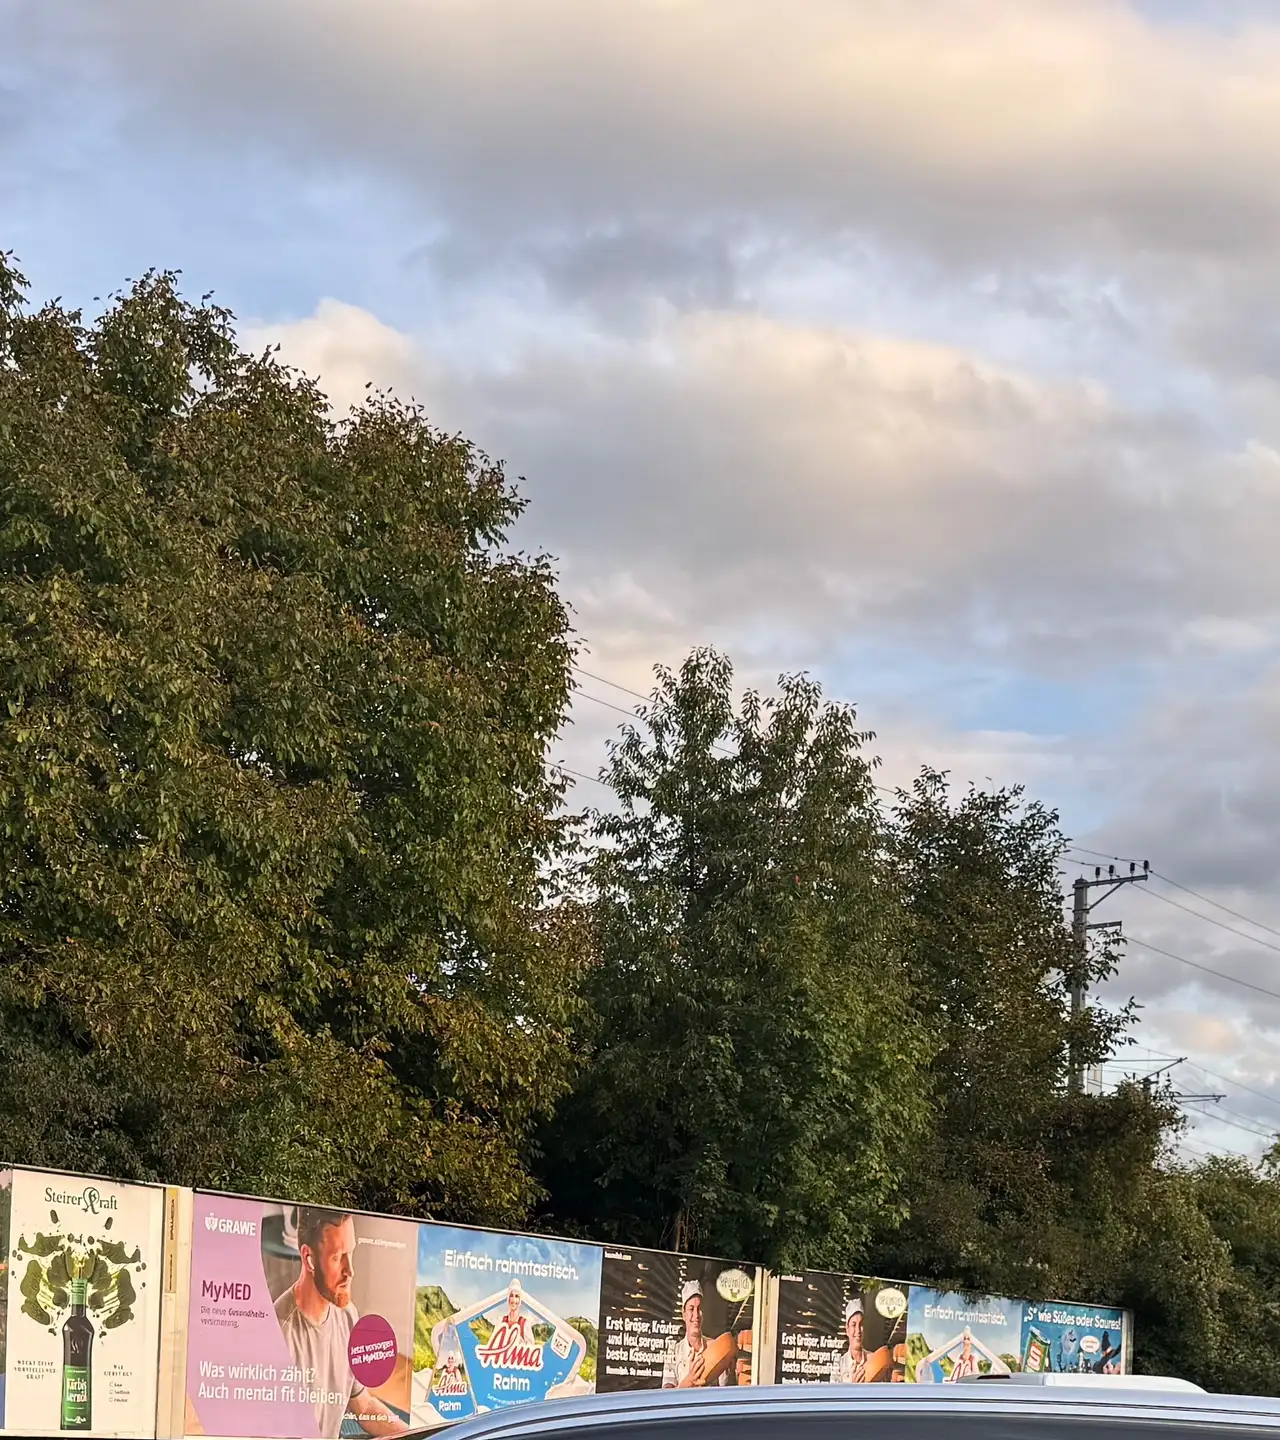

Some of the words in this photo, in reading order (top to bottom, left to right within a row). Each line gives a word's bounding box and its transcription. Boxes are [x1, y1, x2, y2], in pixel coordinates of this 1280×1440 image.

[218, 1218, 257, 1236] GRAWE
[444, 1249, 493, 1271] Einfach
[495, 1257, 579, 1281] rahmtastisch.
[201, 1279, 252, 1303] MyMED
[924, 1304, 954, 1321] Einfach
[1075, 1314, 1094, 1328] oder
[477, 1324, 543, 1370] Alma
[199, 1360, 225, 1378] Was
[228, 1363, 277, 1381] wirklich
[279, 1365, 316, 1384] zählt?
[493, 1373, 531, 1392] Rahm
[198, 1382, 229, 1399] Auch
[233, 1385, 277, 1402] mental
[280, 1385, 295, 1402] fit
[298, 1387, 346, 1406] bleiben.
[438, 1400, 462, 1413] Rahm
